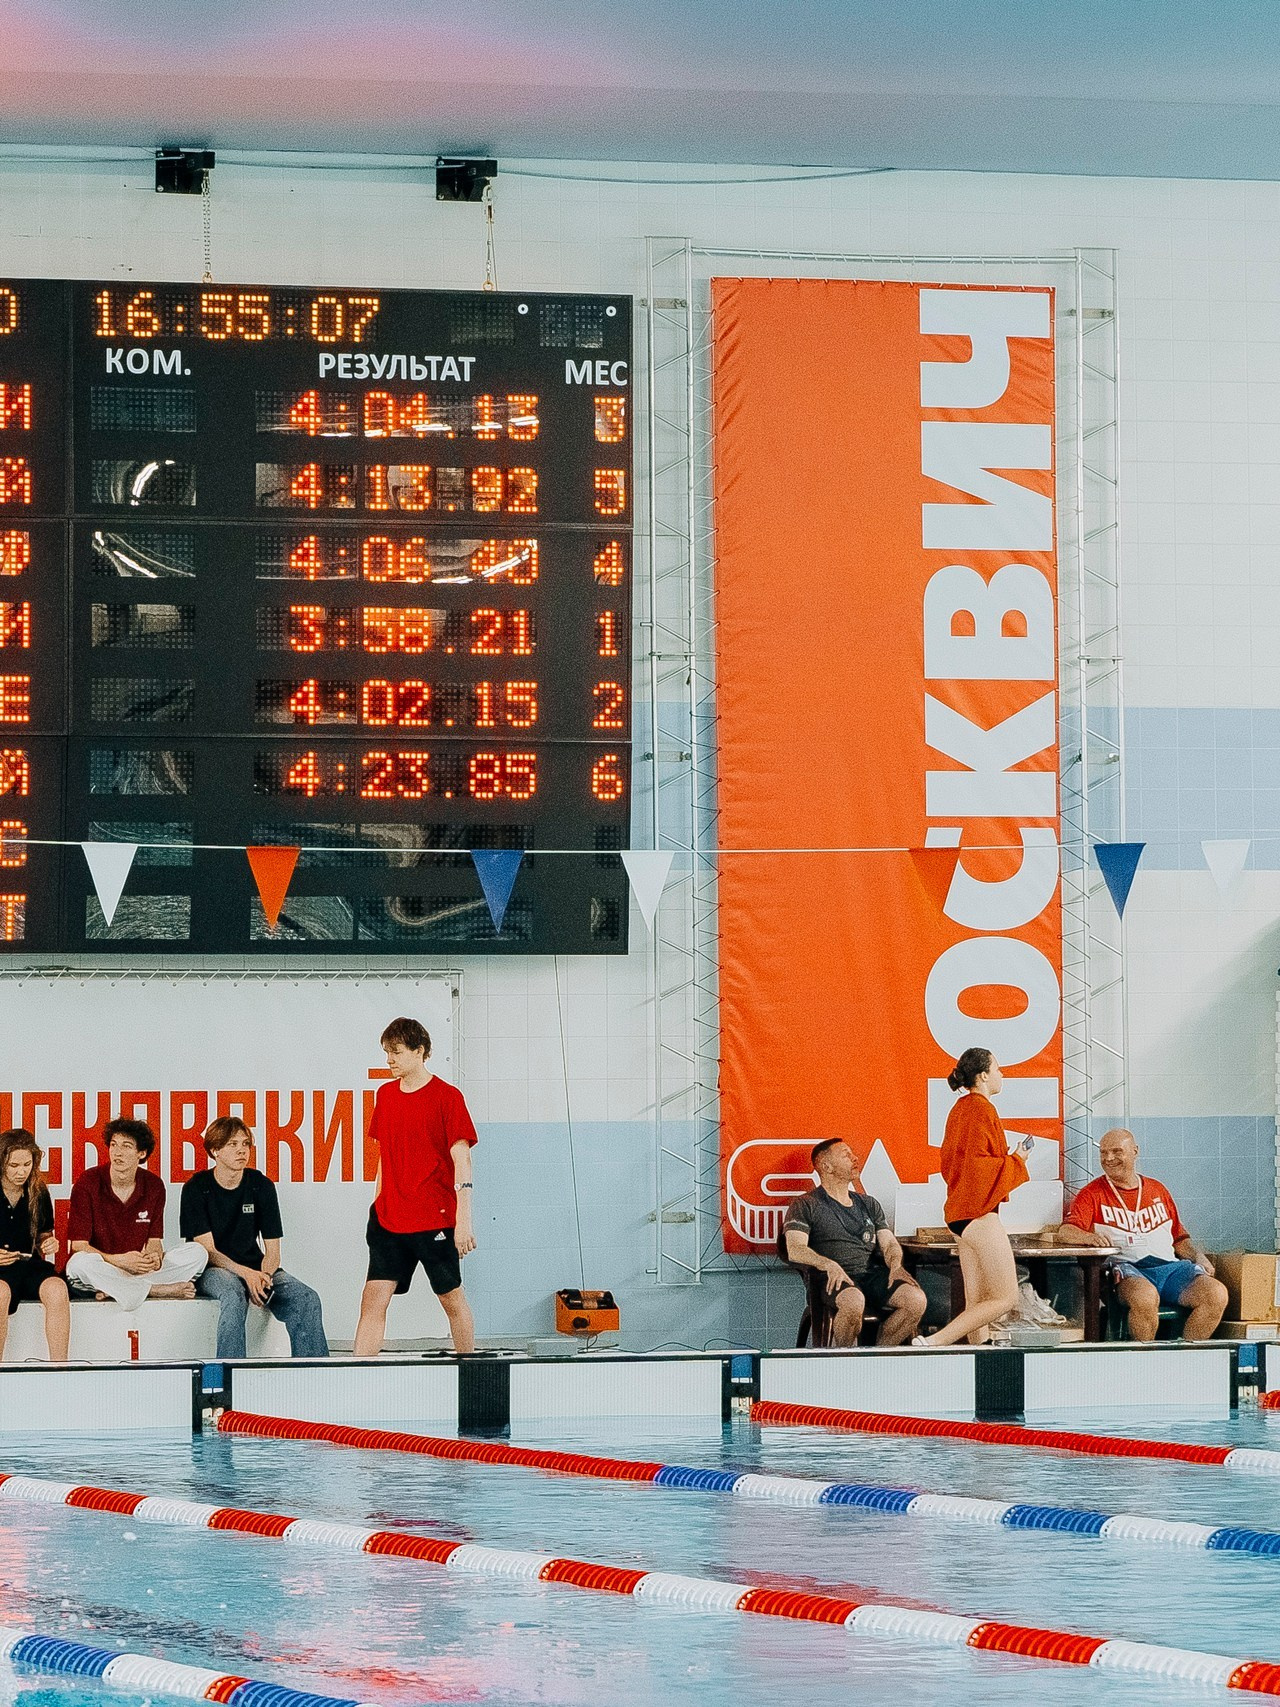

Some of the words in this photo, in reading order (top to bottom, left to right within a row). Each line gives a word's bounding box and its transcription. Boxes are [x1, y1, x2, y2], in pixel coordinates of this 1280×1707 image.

[96, 291, 379, 342] 16:55:07
[105, 347, 192, 376] КОМ.
[318, 352, 477, 382] РЕЗУЛЬТАТ
[564, 359, 629, 387] МЕС
[291, 464, 538, 513] 4:13.92
[594, 470, 625, 515] 5
[593, 541, 624, 586] 4
[290, 606, 532, 654] 3:58.21
[599, 611, 617, 656] 1
[290, 679, 537, 727] 4:02.15
[592, 682, 622, 727] 2
[289, 752, 536, 799] 4:23.85
[592, 755, 622, 799] 6
